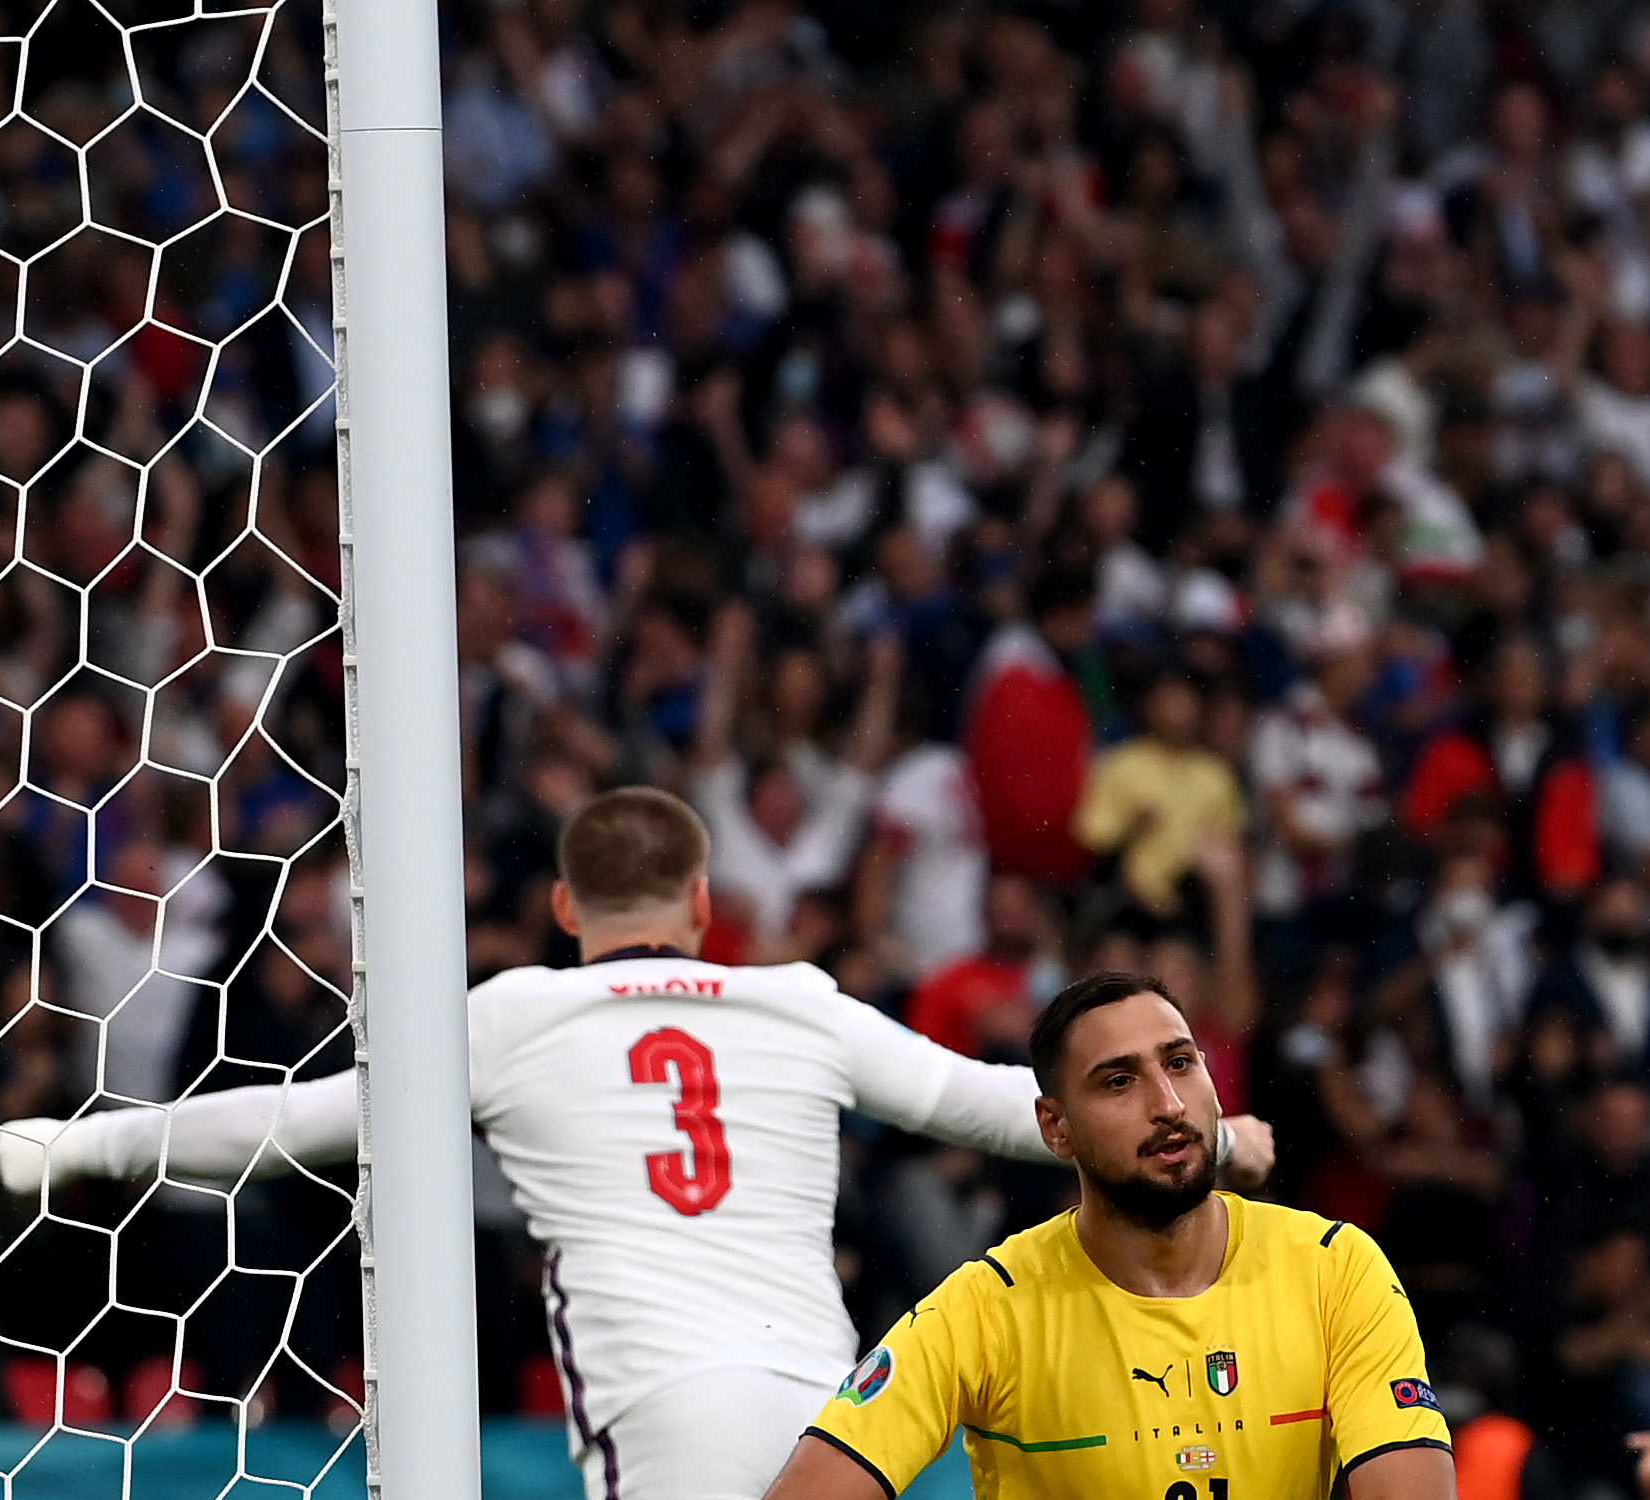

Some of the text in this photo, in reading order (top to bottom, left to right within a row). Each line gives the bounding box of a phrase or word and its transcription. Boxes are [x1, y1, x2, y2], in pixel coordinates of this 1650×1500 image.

[629, 1027, 731, 1216] 3
[1207, 1354, 1234, 1364] ITALIA
[1134, 1420, 1244, 1441] ITALIA
